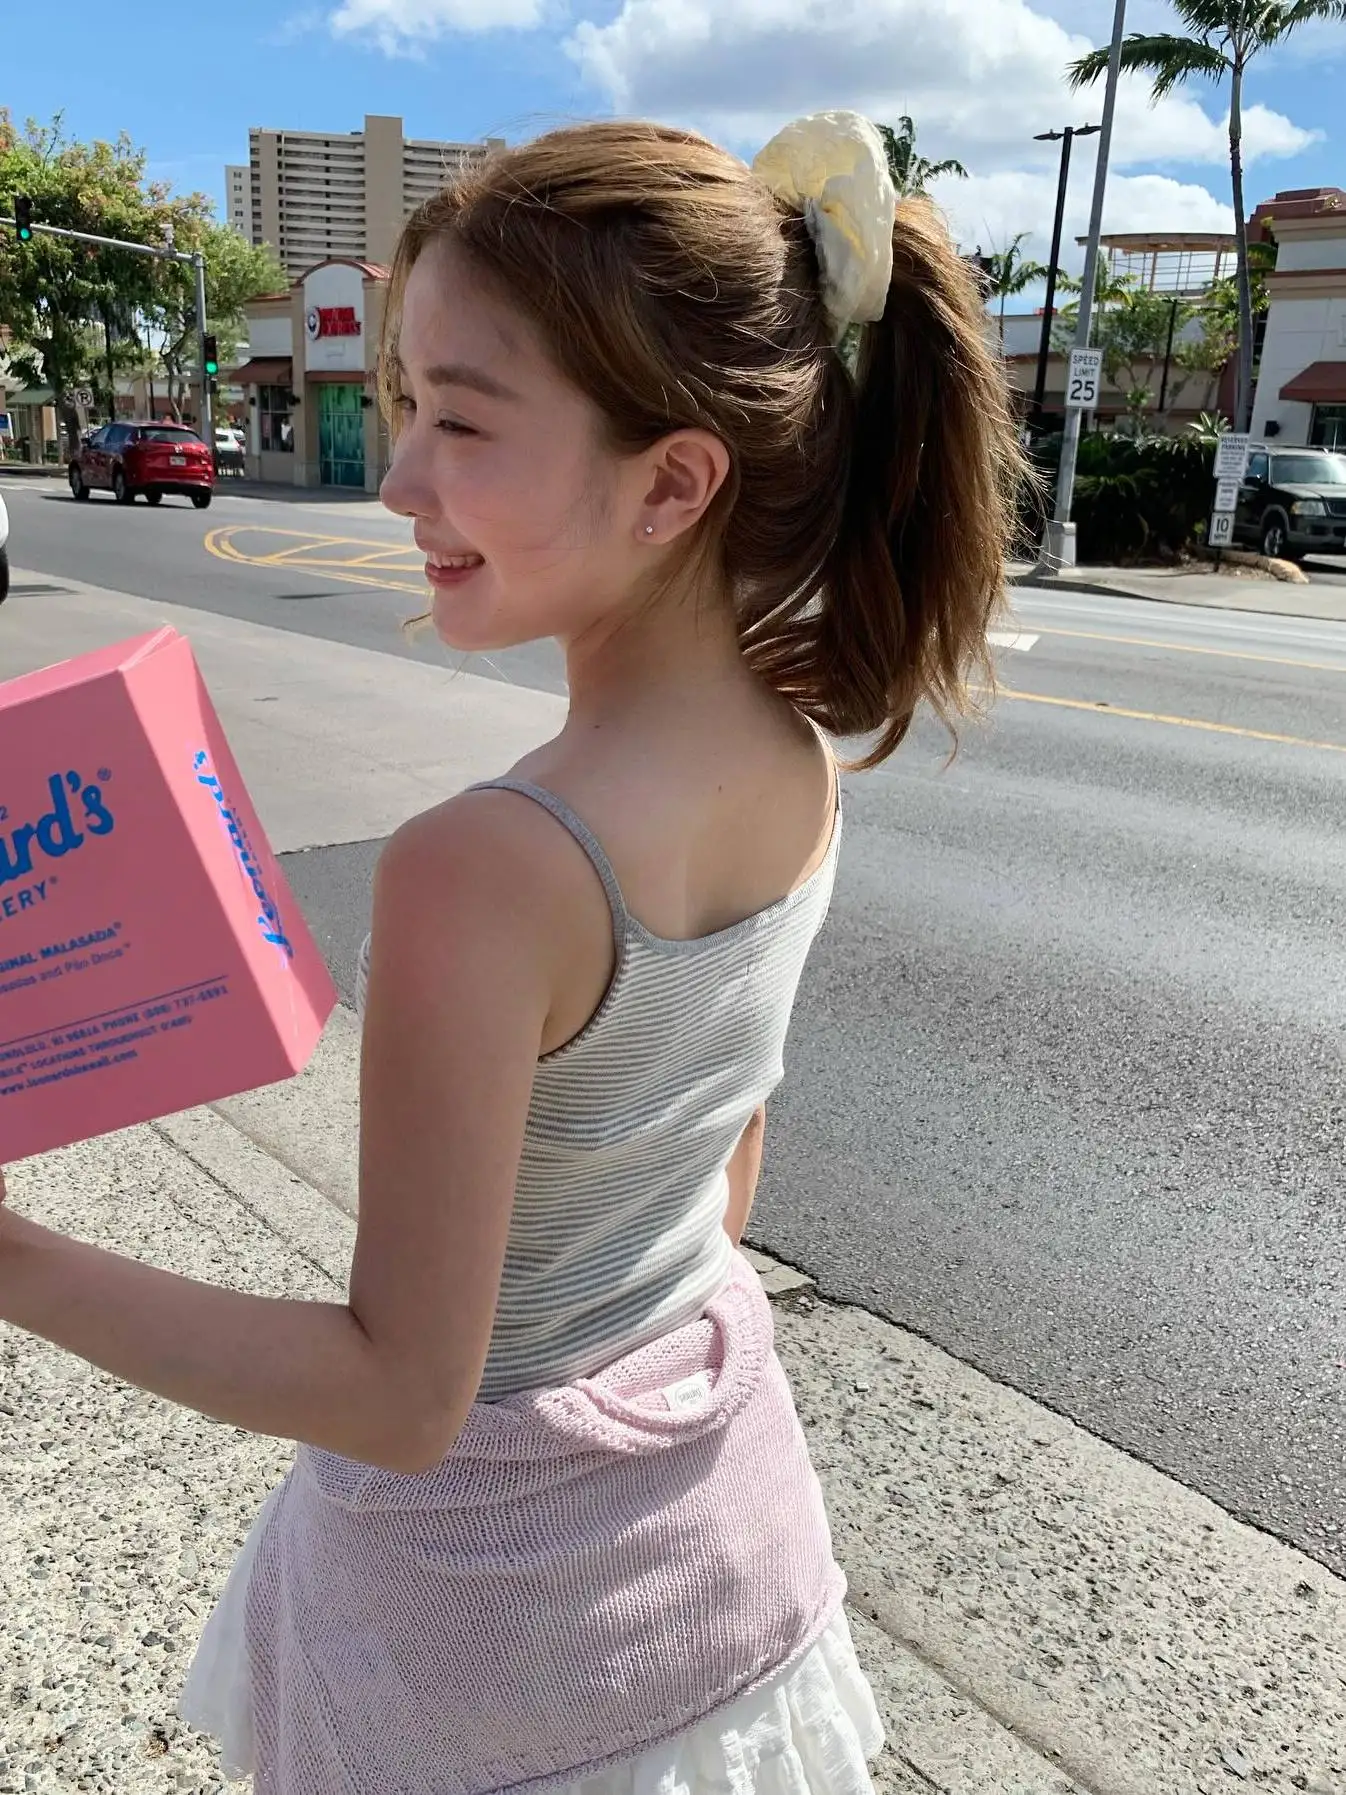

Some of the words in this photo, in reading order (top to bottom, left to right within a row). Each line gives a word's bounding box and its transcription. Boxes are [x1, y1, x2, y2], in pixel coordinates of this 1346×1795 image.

[1072, 354, 1099, 366] SPEED
[1074, 368, 1095, 377] LIMIT
[1070, 379, 1095, 402] 25
[1216, 518, 1230, 532] 10
